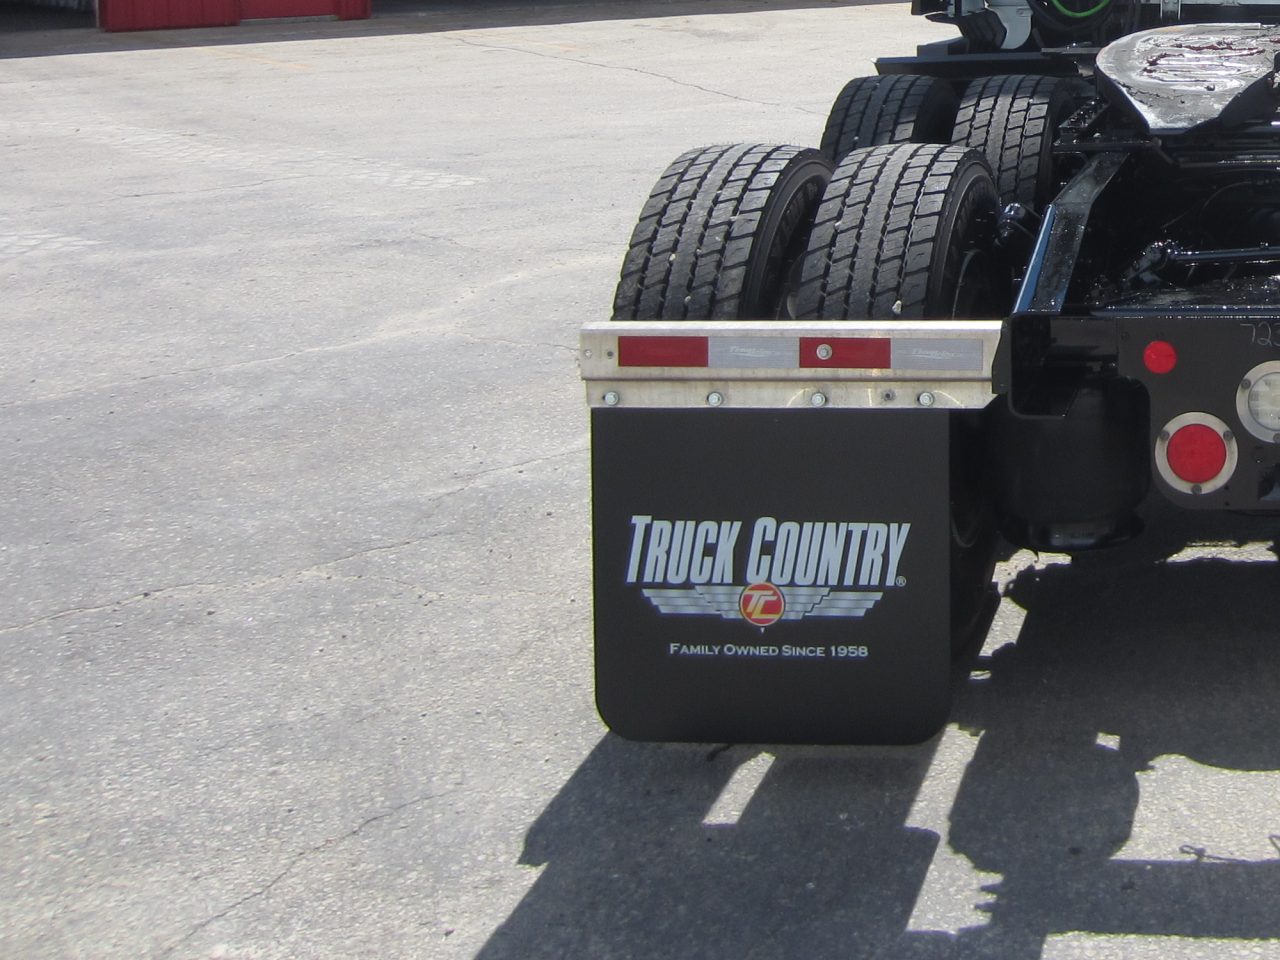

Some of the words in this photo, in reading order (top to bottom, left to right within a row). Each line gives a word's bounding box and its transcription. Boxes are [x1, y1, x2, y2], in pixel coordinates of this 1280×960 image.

[626, 515, 742, 584] TRUCK
[670, 642, 721, 656] FAMILY
[723, 643, 779, 657] OWNED
[782, 644, 826, 657] SINCE
[830, 645, 869, 658] 1958
